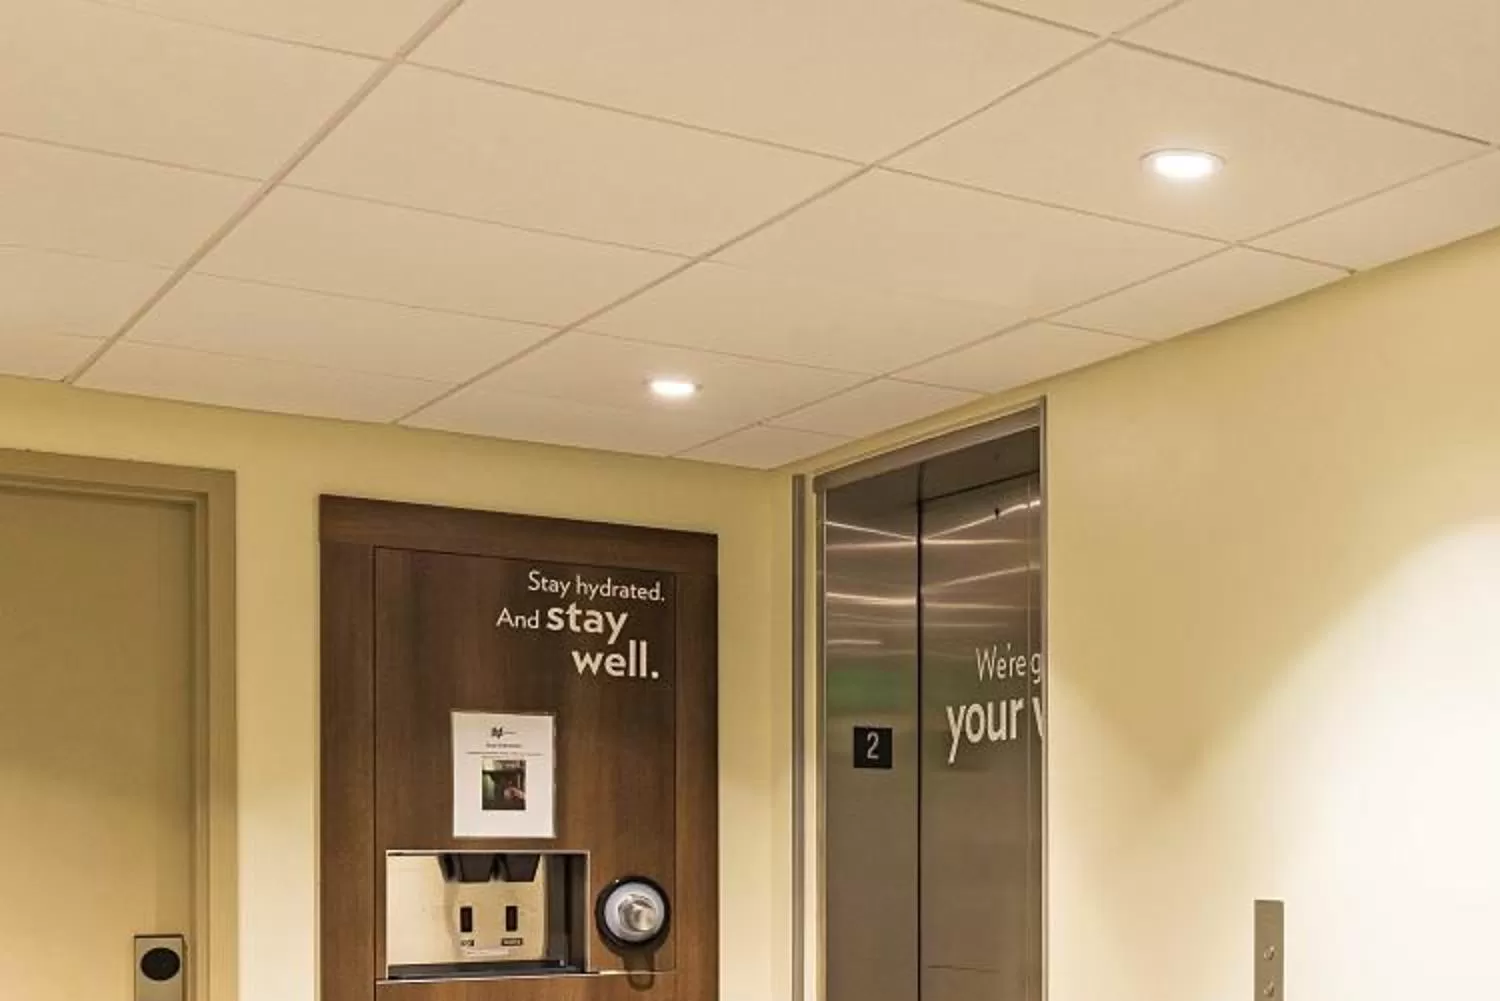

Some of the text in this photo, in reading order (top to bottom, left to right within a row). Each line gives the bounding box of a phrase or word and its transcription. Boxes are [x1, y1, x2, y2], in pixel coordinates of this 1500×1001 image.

[528, 569, 665, 602] Stay hydrated.
[495, 601, 629, 645] And stay
[571, 639, 660, 680] well.
[975, 642, 1027, 681] We're
[866, 731, 880, 760] 2
[945, 698, 1025, 766] your
